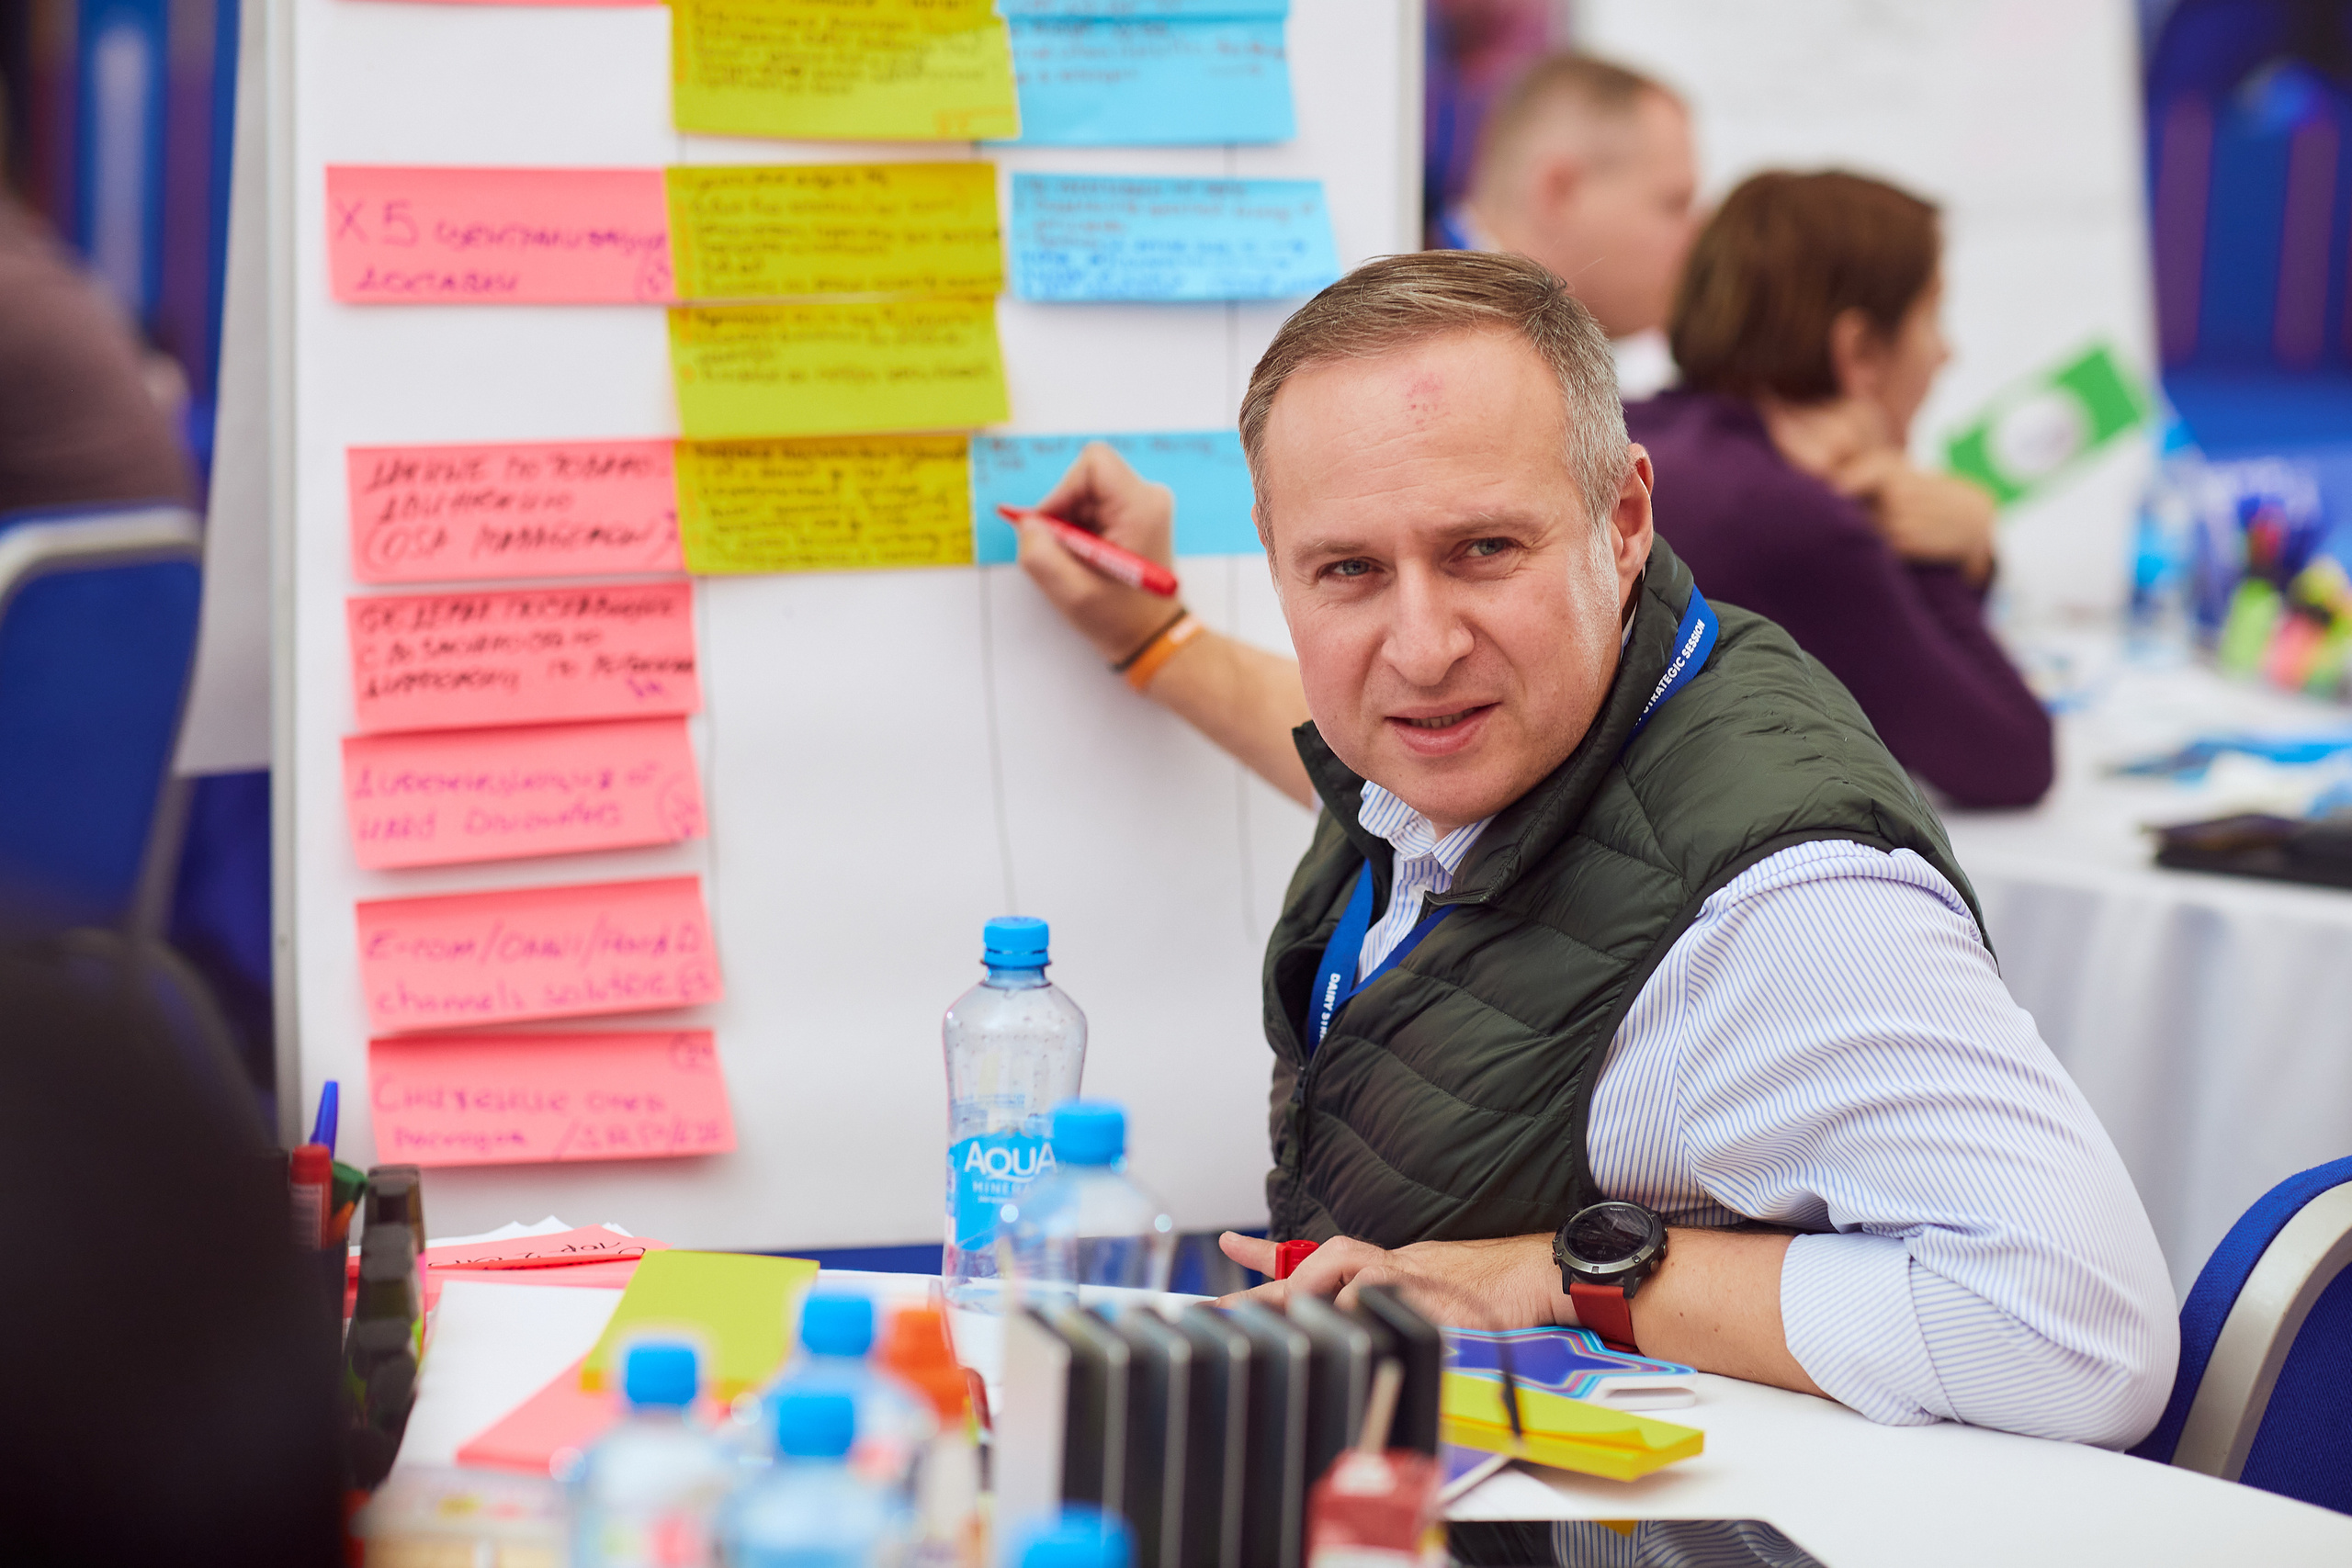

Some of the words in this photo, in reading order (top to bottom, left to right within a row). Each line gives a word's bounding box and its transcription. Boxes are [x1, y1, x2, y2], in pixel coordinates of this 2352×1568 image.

[1680, 618, 1706, 659] SESSION
[1323, 972, 1341, 1011] DAIRY
[965, 1140, 1057, 1183] AQUA
